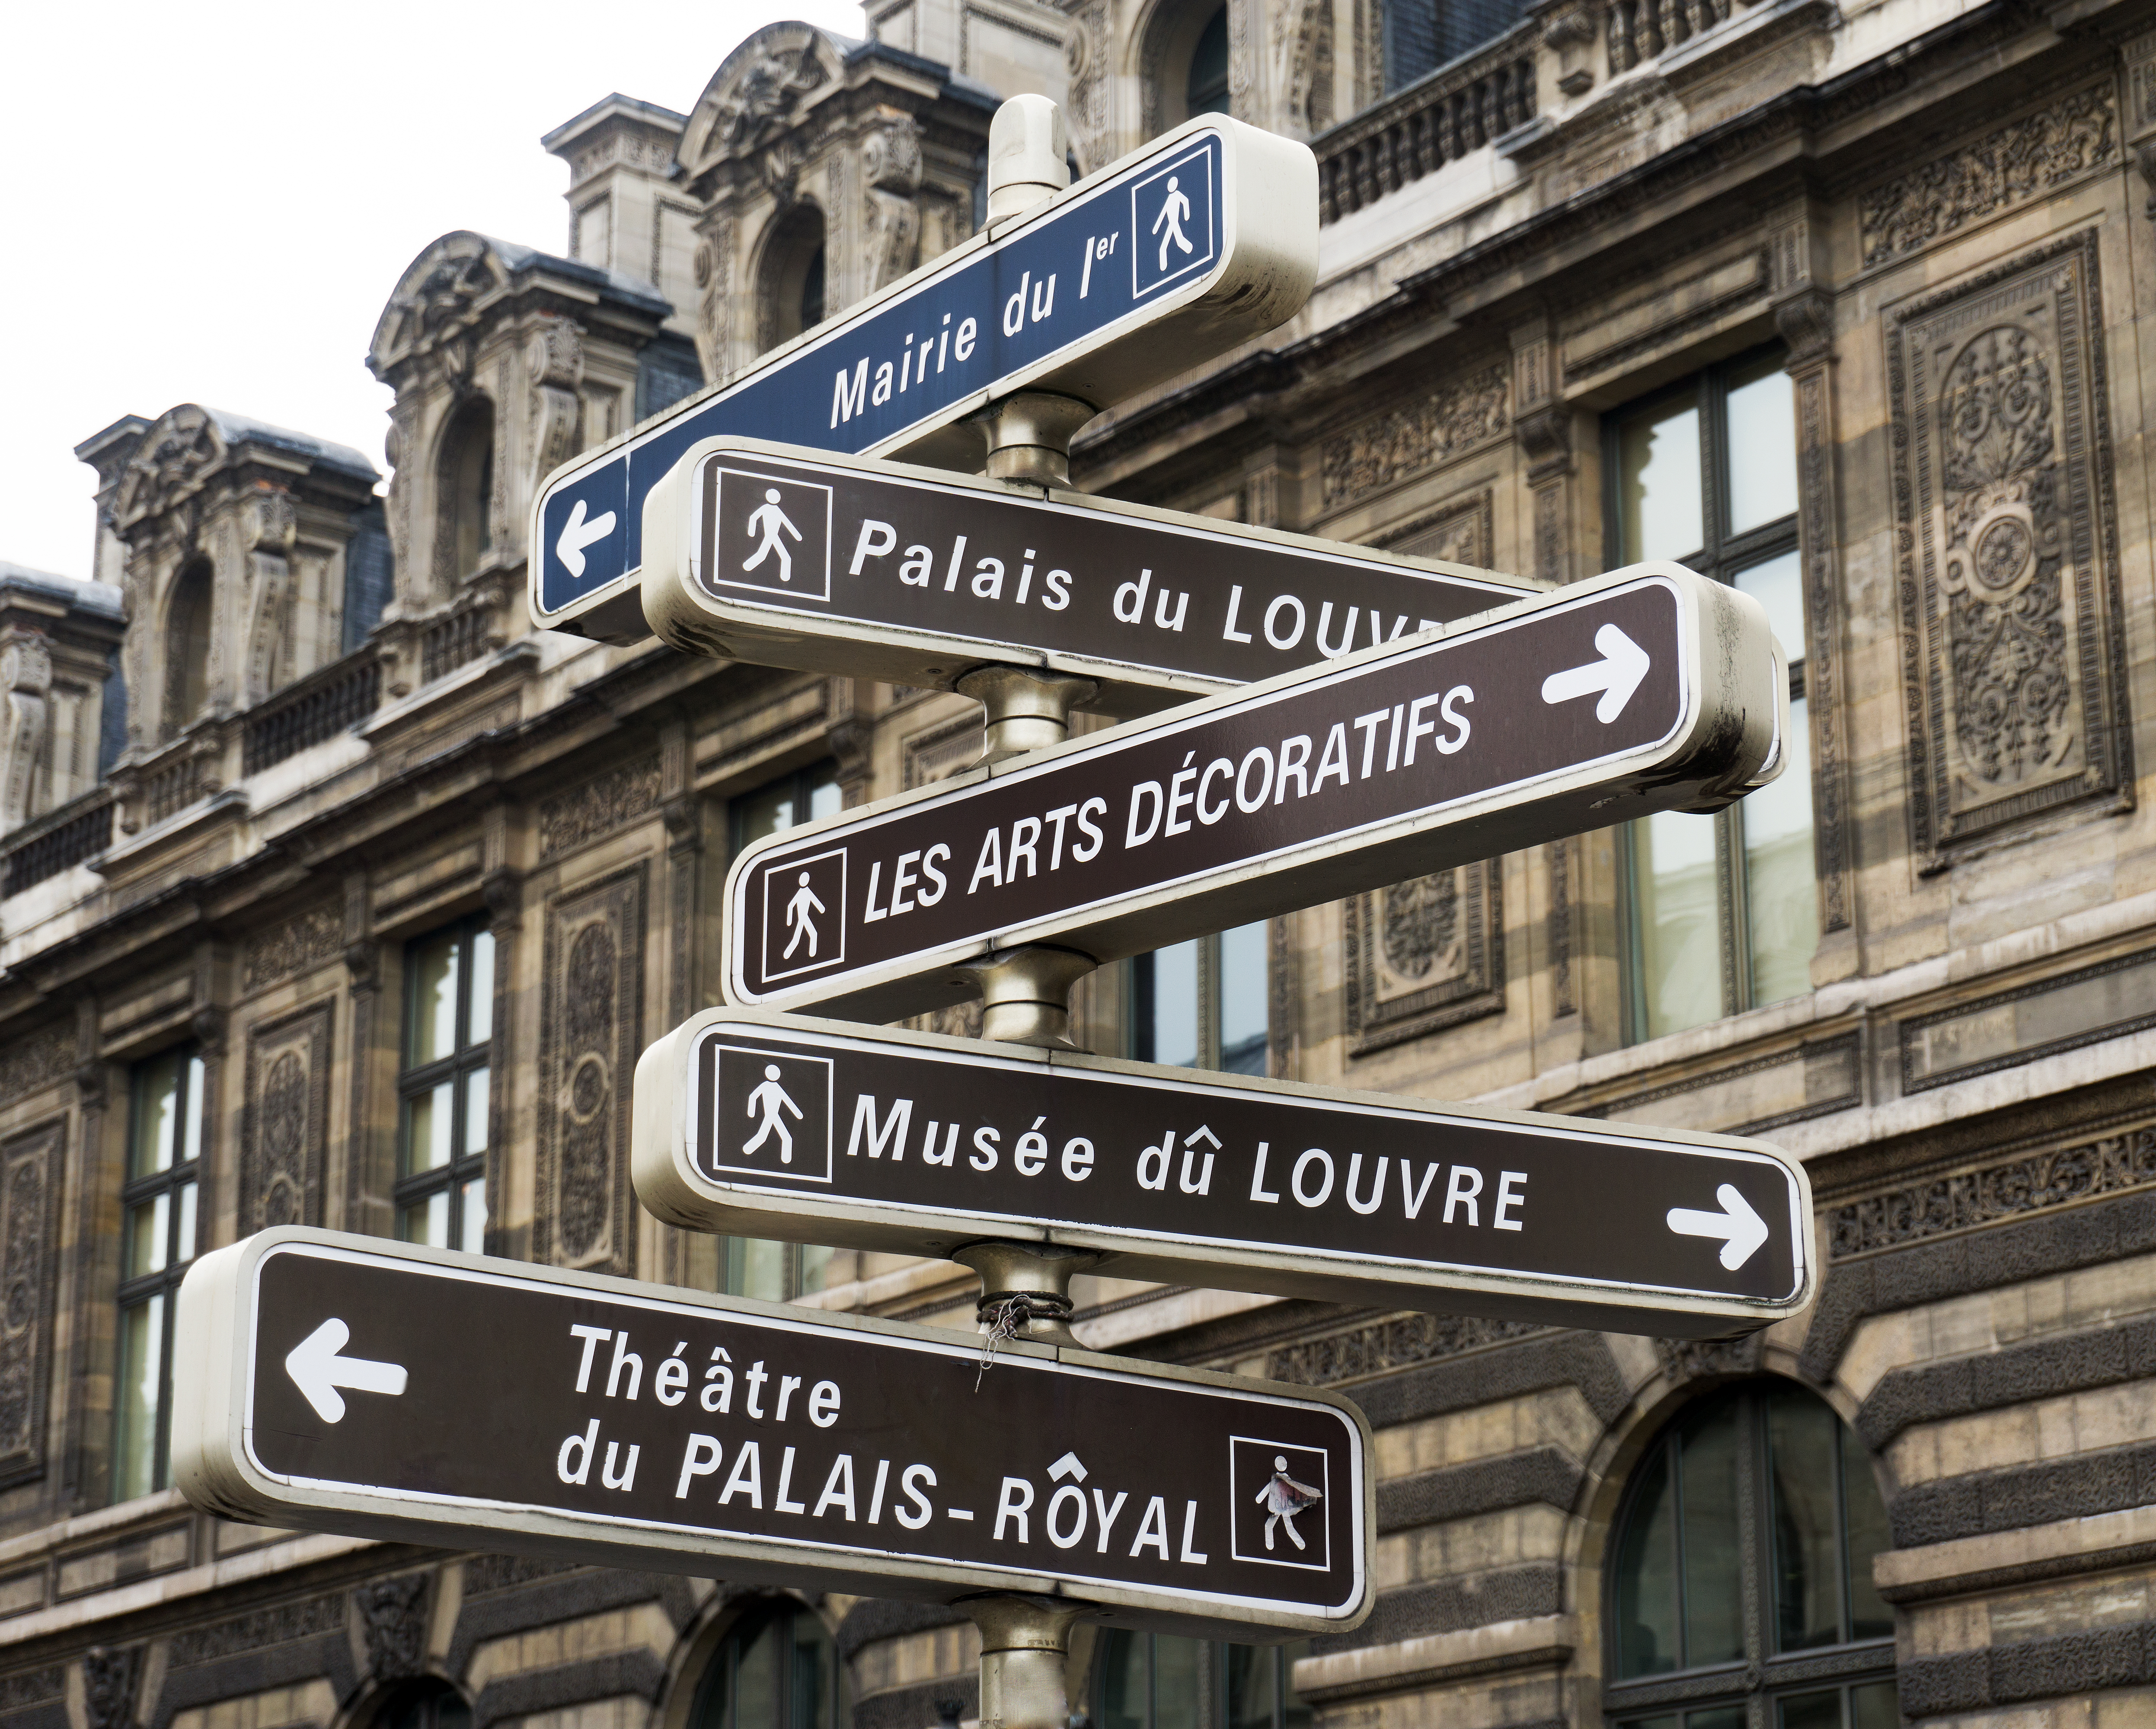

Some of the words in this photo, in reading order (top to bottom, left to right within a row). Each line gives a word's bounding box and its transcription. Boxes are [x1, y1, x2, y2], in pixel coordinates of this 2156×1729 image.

[830, 313, 977, 429] Mairie
[1003, 271, 1057, 337] du
[849, 519, 1072, 610] Palais
[1113, 569, 1190, 632] du
[1223, 585, 1444, 659] LOUV
[864, 843, 951, 923] LES
[967, 797, 1107, 895] ARTS
[1125, 685, 1474, 849] DÉCORATIFS
[847, 1094, 1094, 1181] Musée
[1250, 1142, 1528, 1231] LOUVRE
[570, 1324, 840, 1428] Théâtre
[557, 1419, 640, 1492] du
